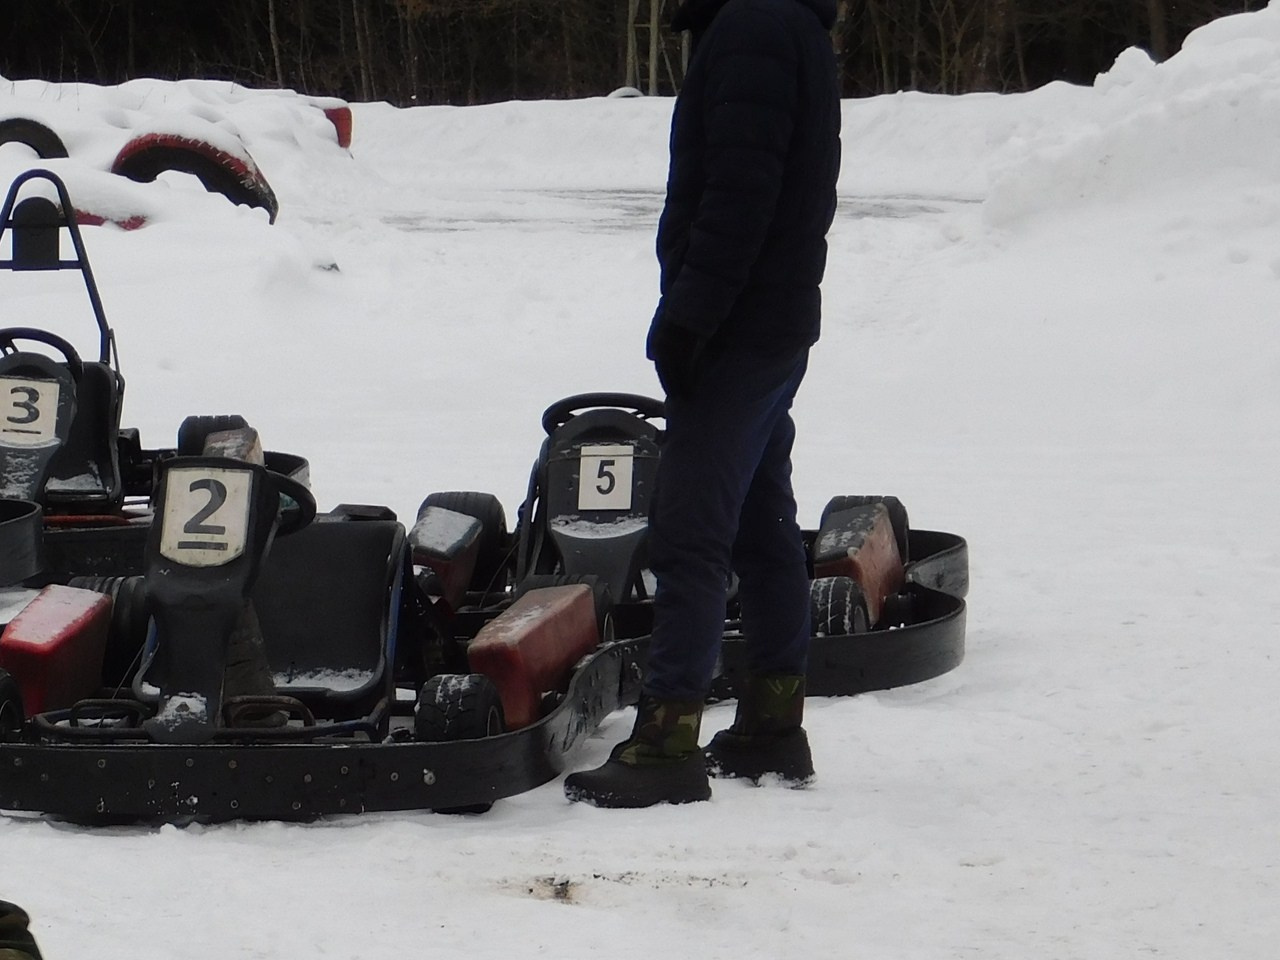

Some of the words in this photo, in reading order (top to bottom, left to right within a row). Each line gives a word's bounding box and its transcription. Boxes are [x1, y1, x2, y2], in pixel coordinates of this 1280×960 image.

[7, 386, 40, 424] 3
[596, 460, 616, 495] 5
[183, 479, 227, 535] 2
